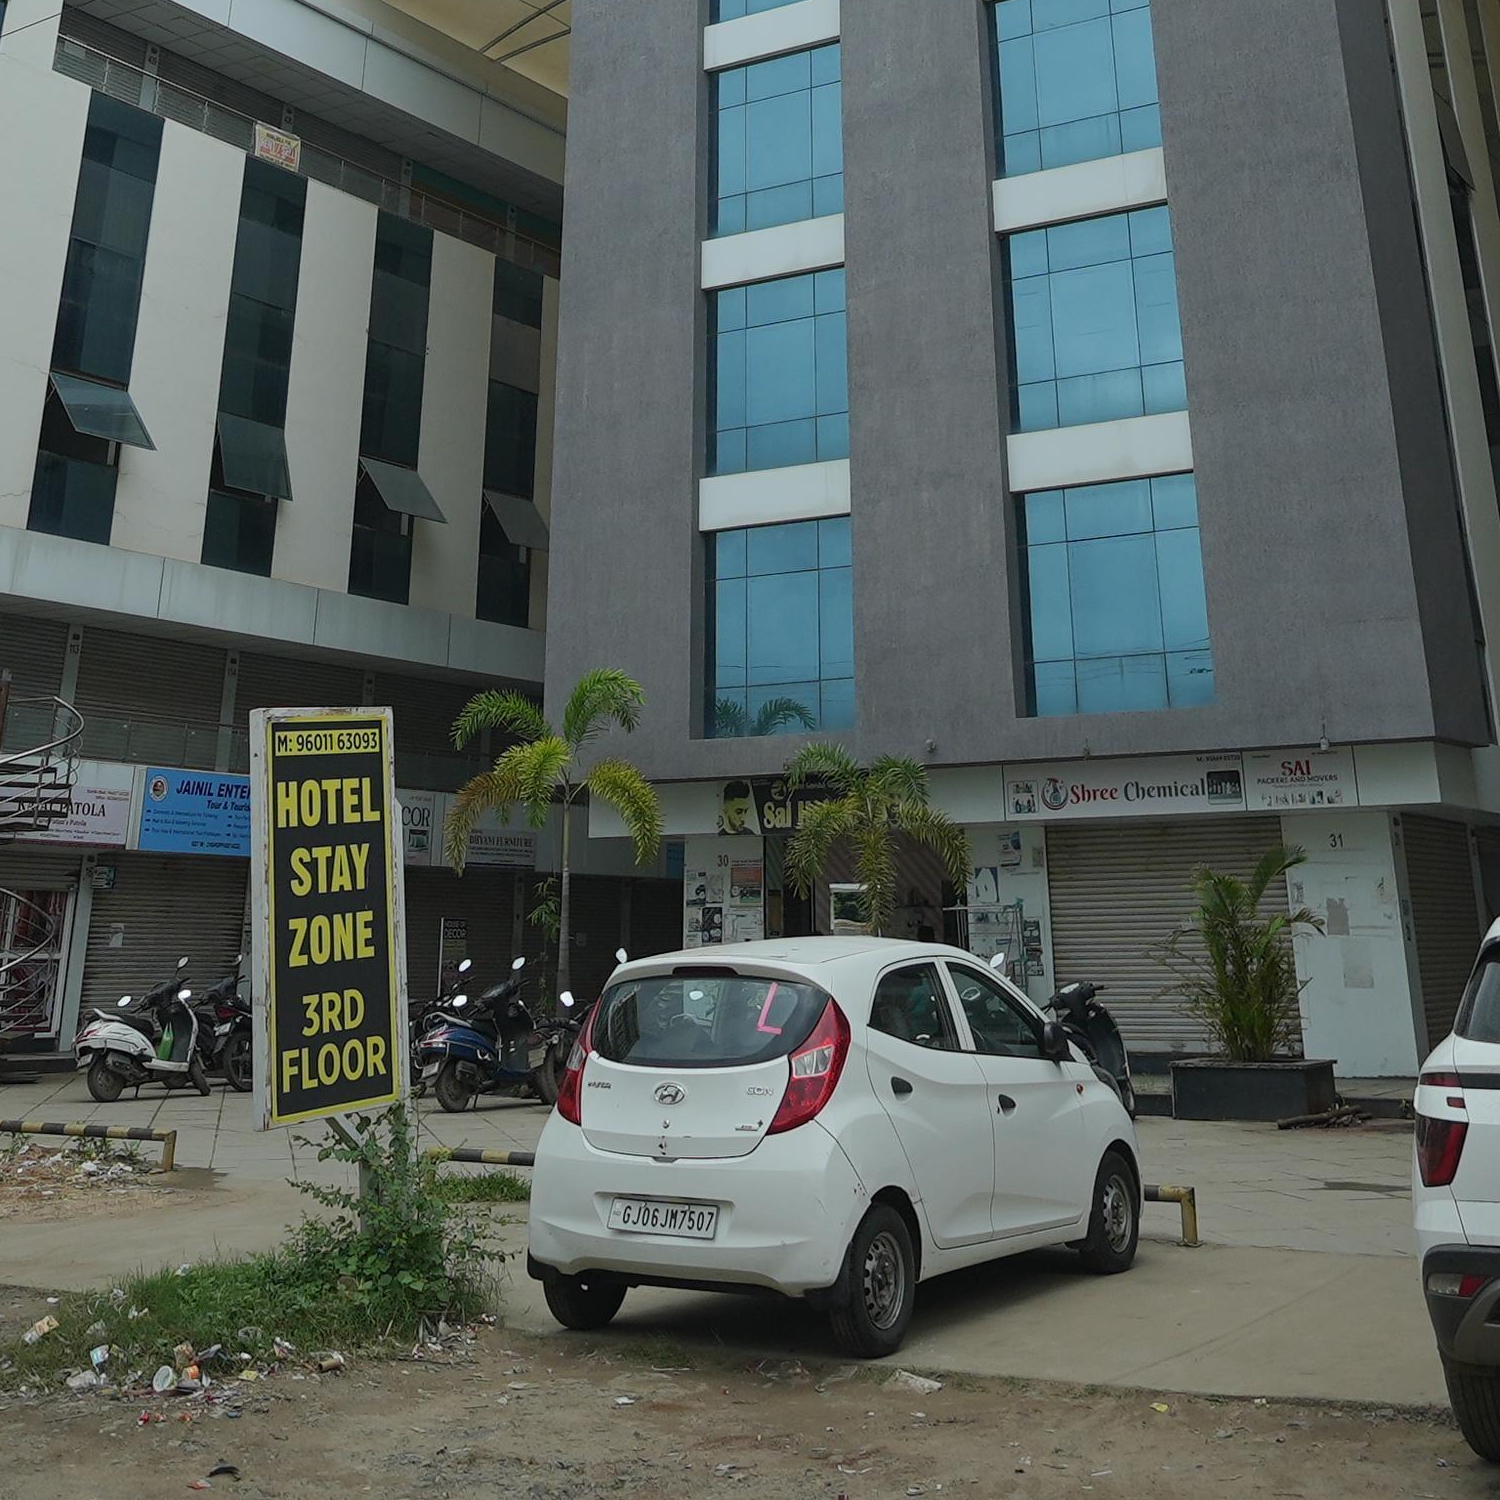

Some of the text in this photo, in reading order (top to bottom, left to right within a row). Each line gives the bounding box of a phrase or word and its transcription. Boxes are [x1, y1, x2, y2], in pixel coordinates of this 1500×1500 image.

[296, 733, 334, 752] 96011
[337, 730, 378, 750] 63093
[1281, 760, 1311, 776] SAI
[176, 780, 213, 796] JAINIL
[1070, 777, 1206, 806] Shree Chemical
[277, 777, 381, 828] HOTEL
[1329, 833, 1344, 848] 31
[289, 844, 369, 896] STAY
[717, 854, 729, 867] 30
[288, 910, 375, 967] ZONE
[302, 989, 365, 1036] 3RD
[282, 1039, 386, 1094] FLOOR
[622, 1205, 714, 1232] GJ06JM7507
